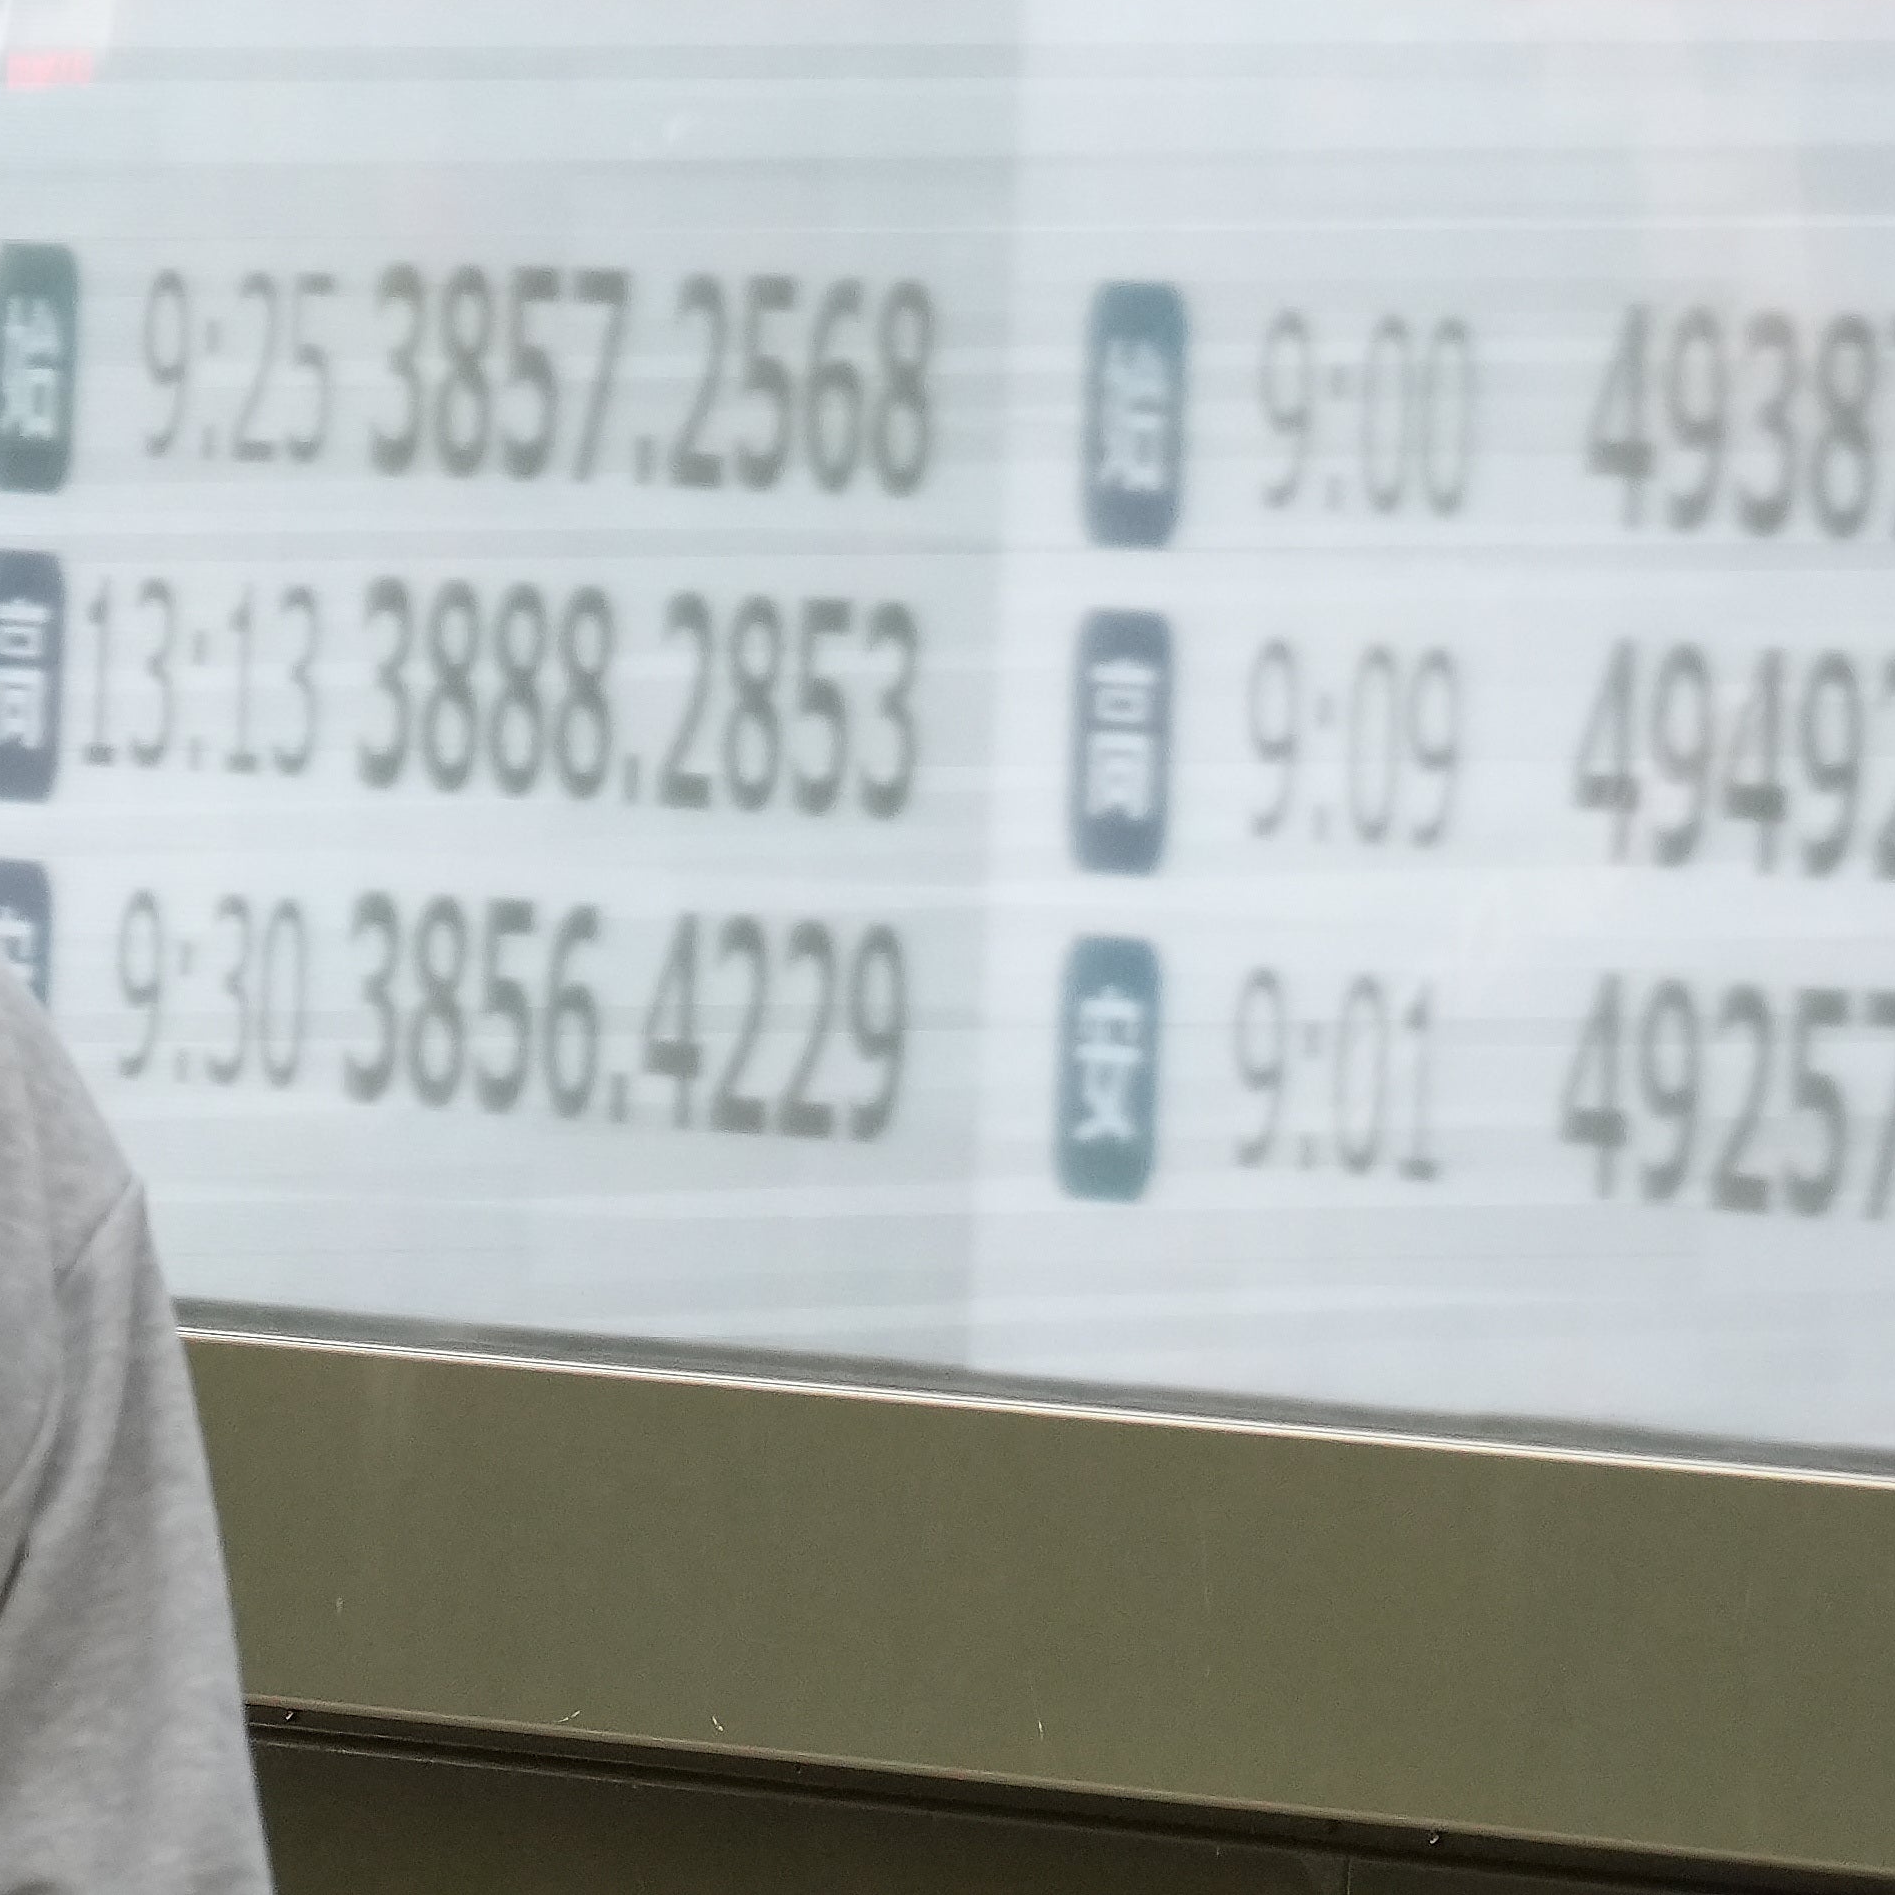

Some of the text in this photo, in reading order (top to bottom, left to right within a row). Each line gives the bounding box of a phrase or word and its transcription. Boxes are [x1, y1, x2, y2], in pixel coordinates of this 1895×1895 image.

[141, 268, 336, 465] 9:25
[369, 262, 938, 499] 3857.2568
[1259, 310, 1476, 519] 9:00
[81, 573, 320, 778] 13:13
[358, 576, 921, 821] 3888.2853
[1246, 637, 1462, 849] 9:09
[114, 888, 308, 1090] 9:30
[343, 889, 908, 1145] 3856.4229
[1233, 966, 1438, 1183] 9:01
